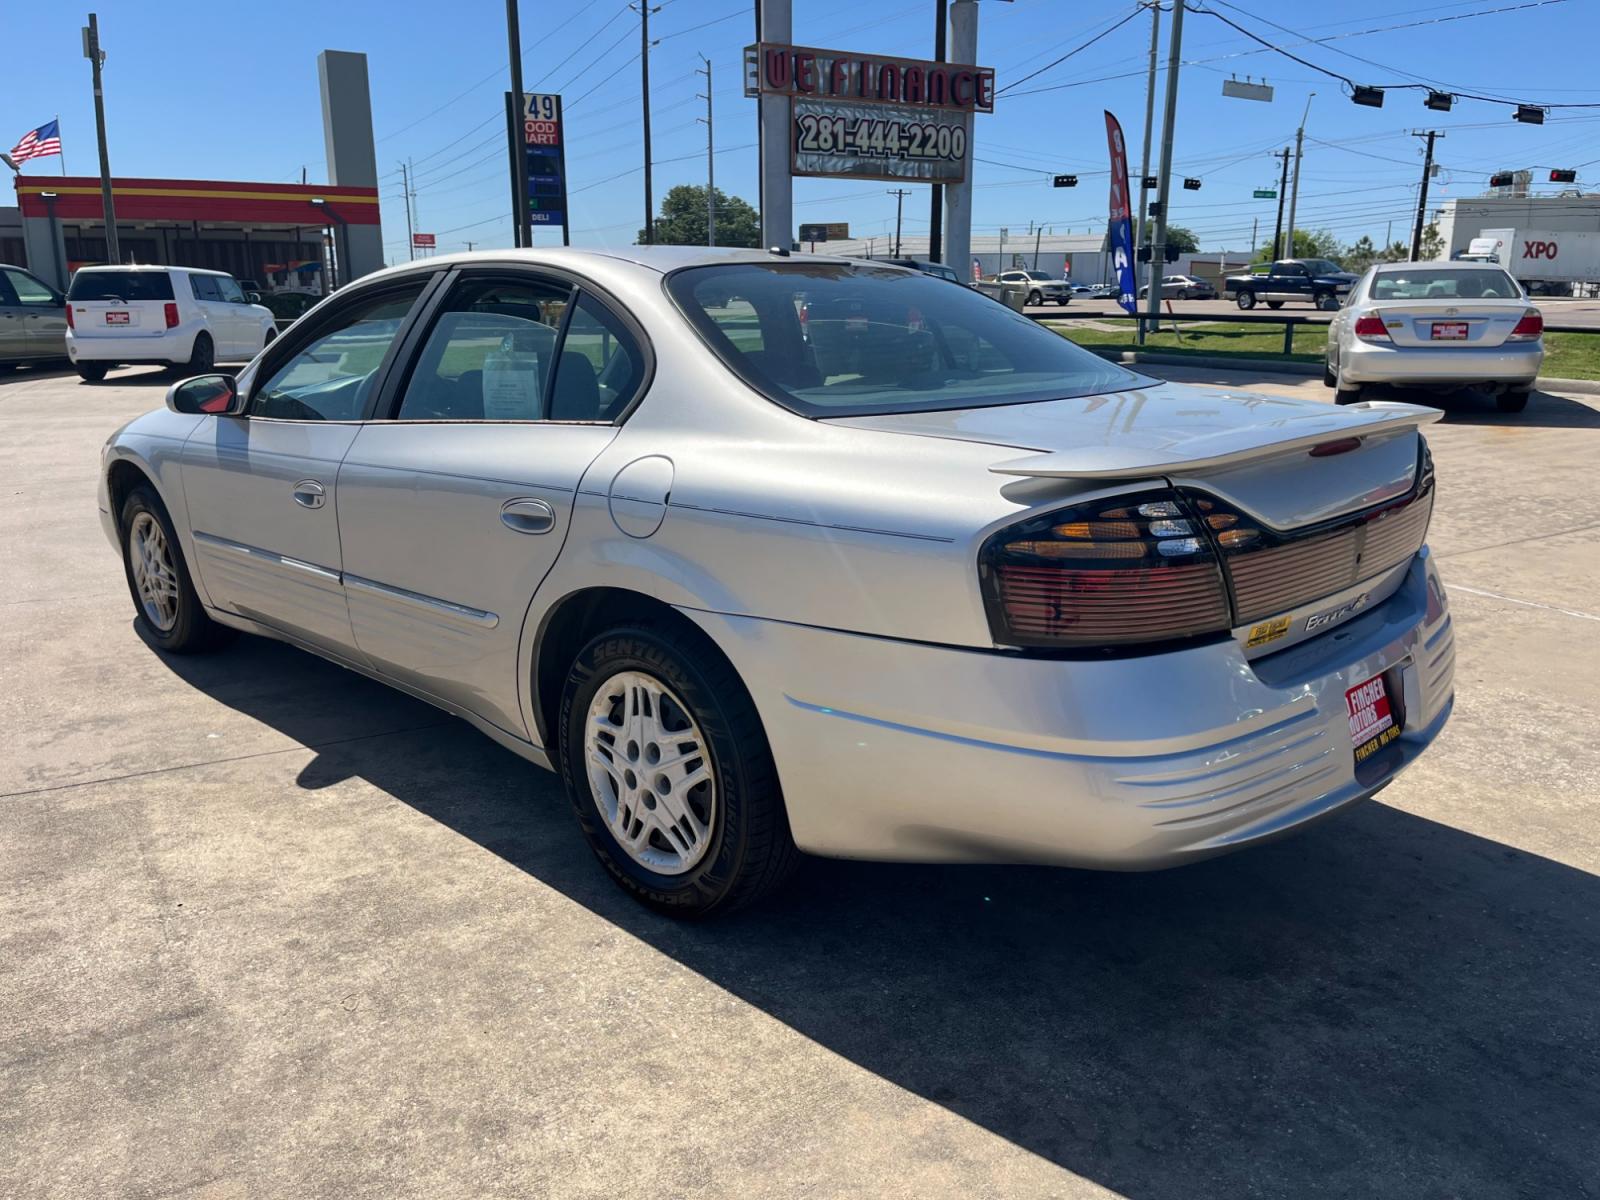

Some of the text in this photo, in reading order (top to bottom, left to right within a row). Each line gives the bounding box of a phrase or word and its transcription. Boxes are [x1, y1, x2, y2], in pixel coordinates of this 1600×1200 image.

[766, 50, 994, 108] WE FINANCE
[524, 122, 555, 134] OOD
[798, 113, 967, 161] 281-444-2200
[531, 213, 549, 221] DELI
[1522, 240, 1558, 260] XPO
[1350, 677, 1386, 714] FINCHER
